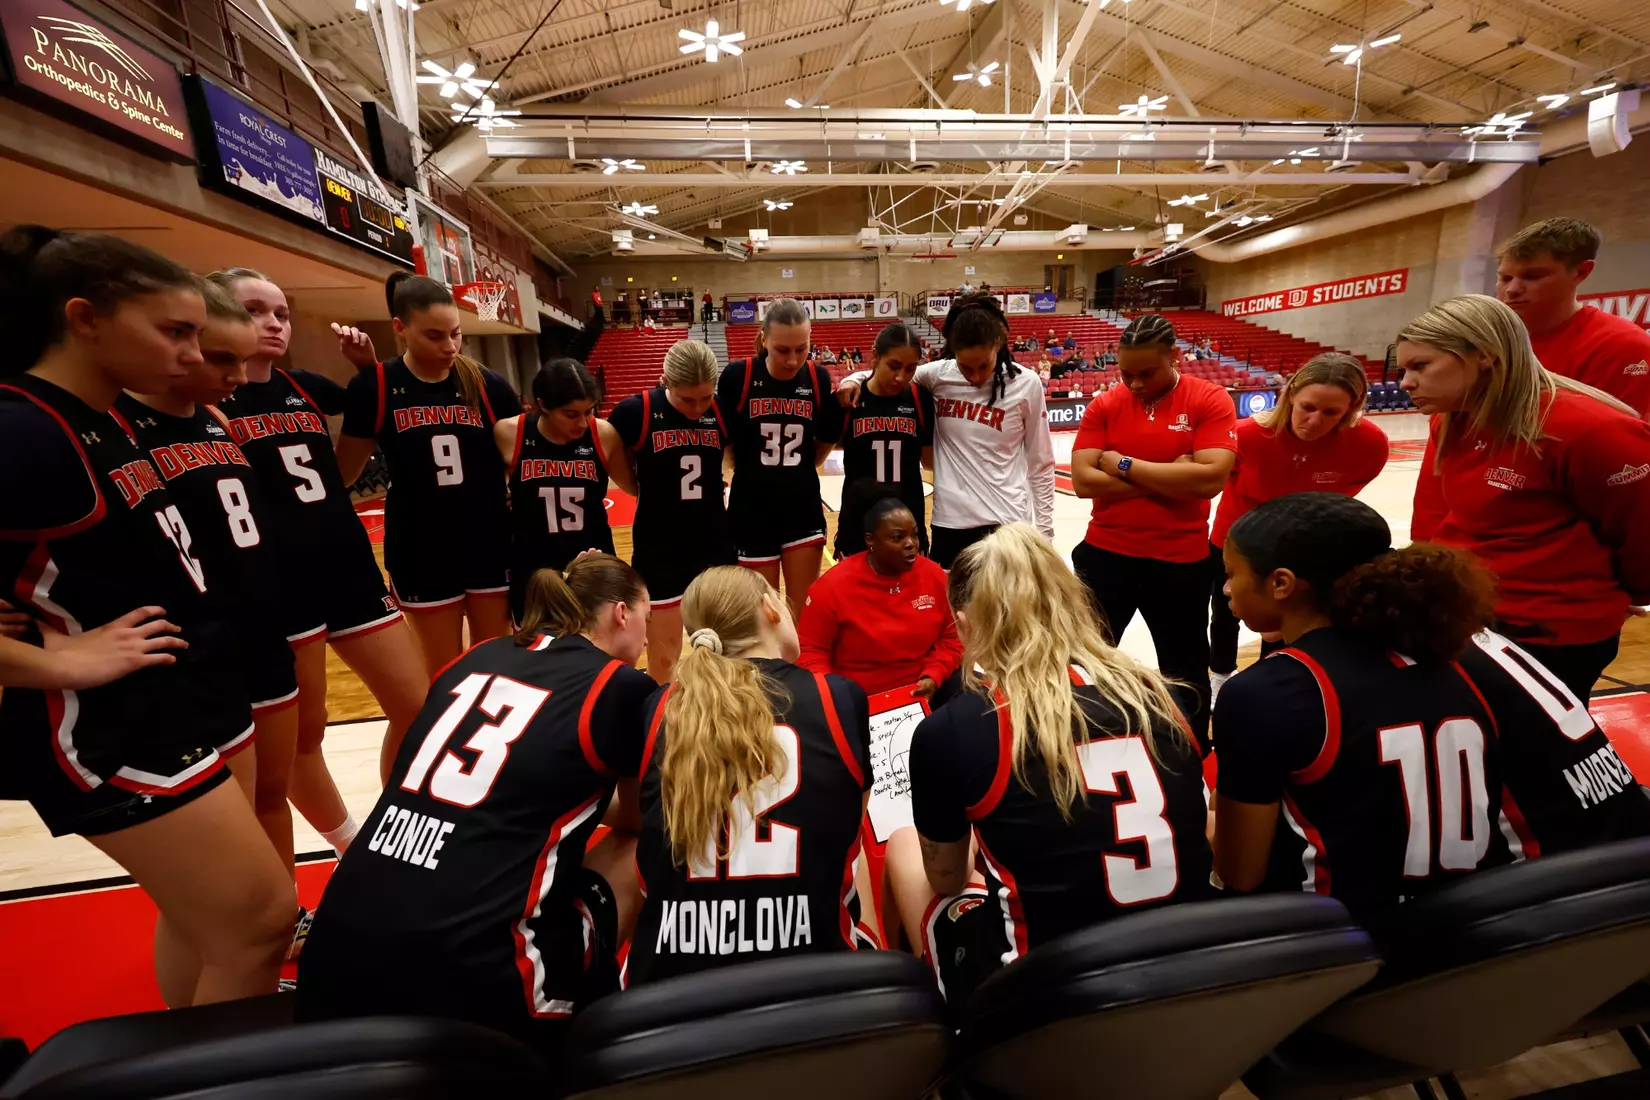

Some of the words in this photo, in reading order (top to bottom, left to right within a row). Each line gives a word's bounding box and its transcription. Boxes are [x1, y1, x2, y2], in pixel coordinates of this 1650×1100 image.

[30, 26, 170, 117] PANORAMA
[24, 54, 106, 104] Orthopedics
[107, 92, 120, 110] &
[121, 101, 151, 124] Spine
[152, 117, 184, 140] Center
[239, 112, 265, 135] ROYAL
[264, 127, 287, 148] CREST
[314, 147, 368, 194] HAMILTON
[325, 178, 353, 203] DENVER
[367, 229, 383, 243] PERIOD
[1223, 294, 1284, 317] WELCOME
[1312, 273, 1403, 304] STUDENTS
[229, 411, 328, 447] DENVER
[394, 405, 484, 434] DENVER
[749, 397, 813, 421] DENVER
[853, 416, 917, 438] DENVER
[936, 398, 1006, 433] DENVER
[431, 433, 464, 487] 9
[652, 428, 721, 453] DENVER
[759, 422, 805, 467] 32
[871, 439, 902, 483] 11
[277, 443, 327, 503] 5
[520, 458, 599, 482] DENVER
[680, 454, 703, 501] 2
[1483, 467, 1527, 489] DENVER
[216, 477, 261, 548] 8
[538, 486, 586, 533] 15
[1471, 626, 1597, 742] 0
[400, 671, 553, 808] 13
[1376, 715, 1492, 878] 10
[367, 804, 456, 871] CONDE
[1075, 734, 1179, 907] 3
[654, 894, 813, 956] MONCLOVA
